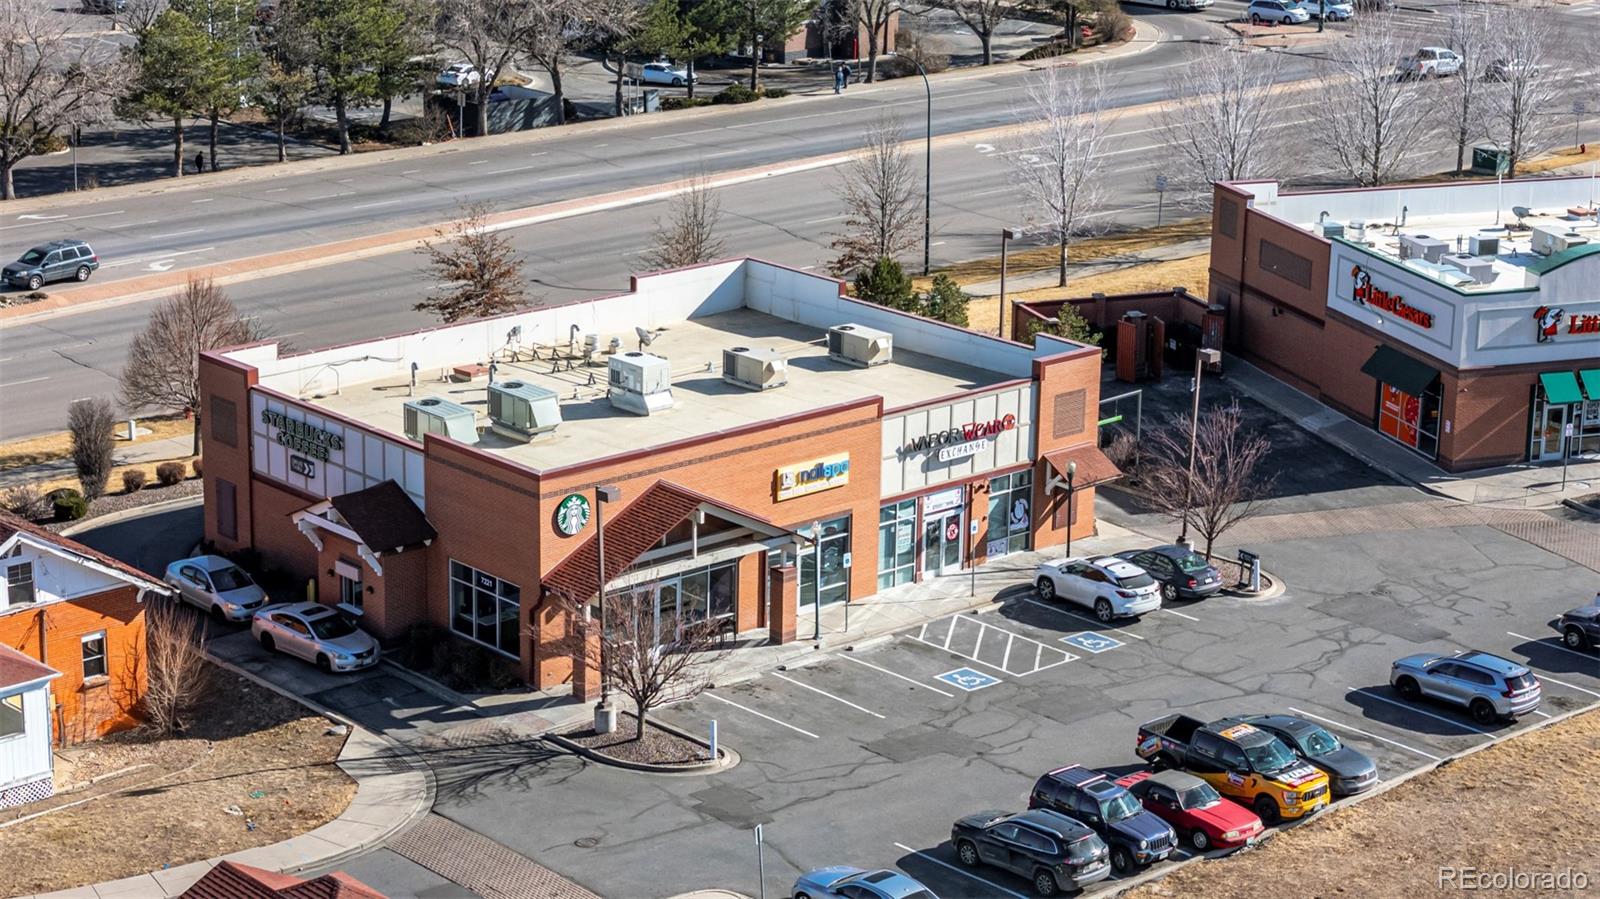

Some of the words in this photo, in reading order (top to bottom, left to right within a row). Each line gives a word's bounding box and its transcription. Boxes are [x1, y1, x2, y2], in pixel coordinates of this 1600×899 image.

[1568, 314, 1600, 335] Litt
[262, 409, 344, 451] STARBUCKS
[911, 428, 961, 452] VAPOR
[277, 431, 329, 462] COFFEE
[940, 440, 986, 460] EXCHANGE
